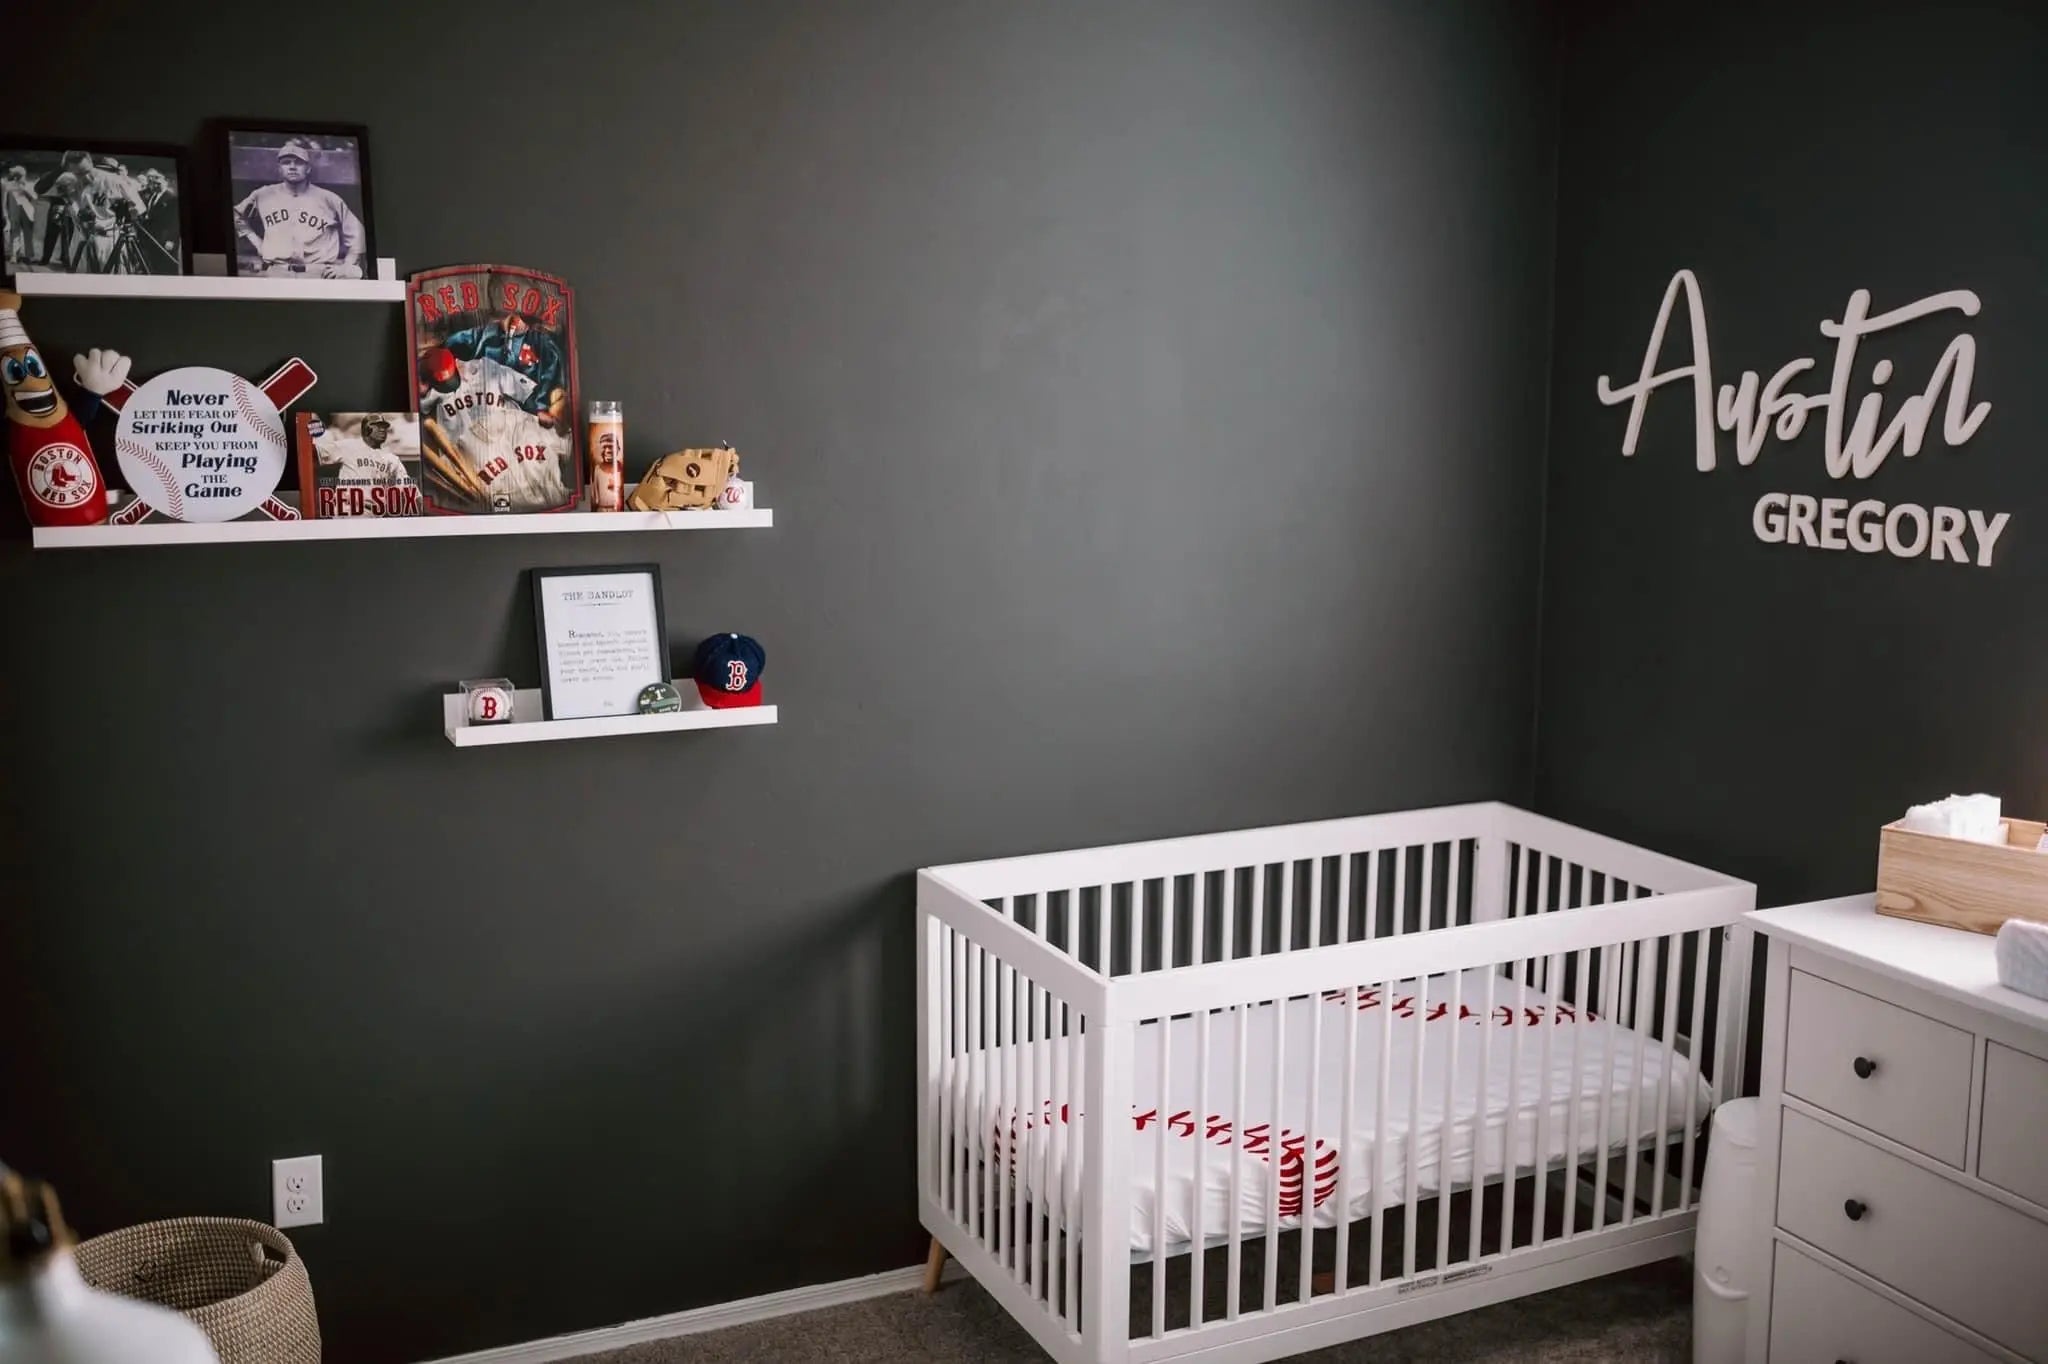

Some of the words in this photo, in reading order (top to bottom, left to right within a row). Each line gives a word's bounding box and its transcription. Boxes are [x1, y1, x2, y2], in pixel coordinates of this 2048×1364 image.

[265, 209, 289, 227] RED
[298, 211, 328, 232] SOX
[417, 281, 479, 322] RED
[503, 283, 564, 326] SOX
[1597, 268, 1992, 479] Austin
[166, 389, 229, 406] Never
[443, 391, 507, 417] BOSTON
[134, 410, 157, 419] LET
[160, 410, 185, 419] THE
[188, 410, 220, 419] FEAR
[222, 410, 239, 419] OF
[132, 421, 204, 439] Striking
[210, 421, 238, 433] Out
[155, 441, 191, 451] KEEP
[193, 441, 220, 450] YOU
[223, 441, 258, 450] FROM
[34, 448, 82, 472] BOSTON
[182, 453, 258, 473] Playing
[478, 456, 508, 485] RED
[514, 445, 547, 464] SOX
[185, 483, 242, 498] Game
[201, 474, 228, 484] THE
[42, 488, 66, 502] RED
[72, 480, 91, 500] SOX
[319, 487, 364, 517] RED
[371, 486, 419, 517] SOX
[1752, 491, 2011, 567] GREGORY
[726, 660, 748, 691] B
[480, 696, 497, 719] B
